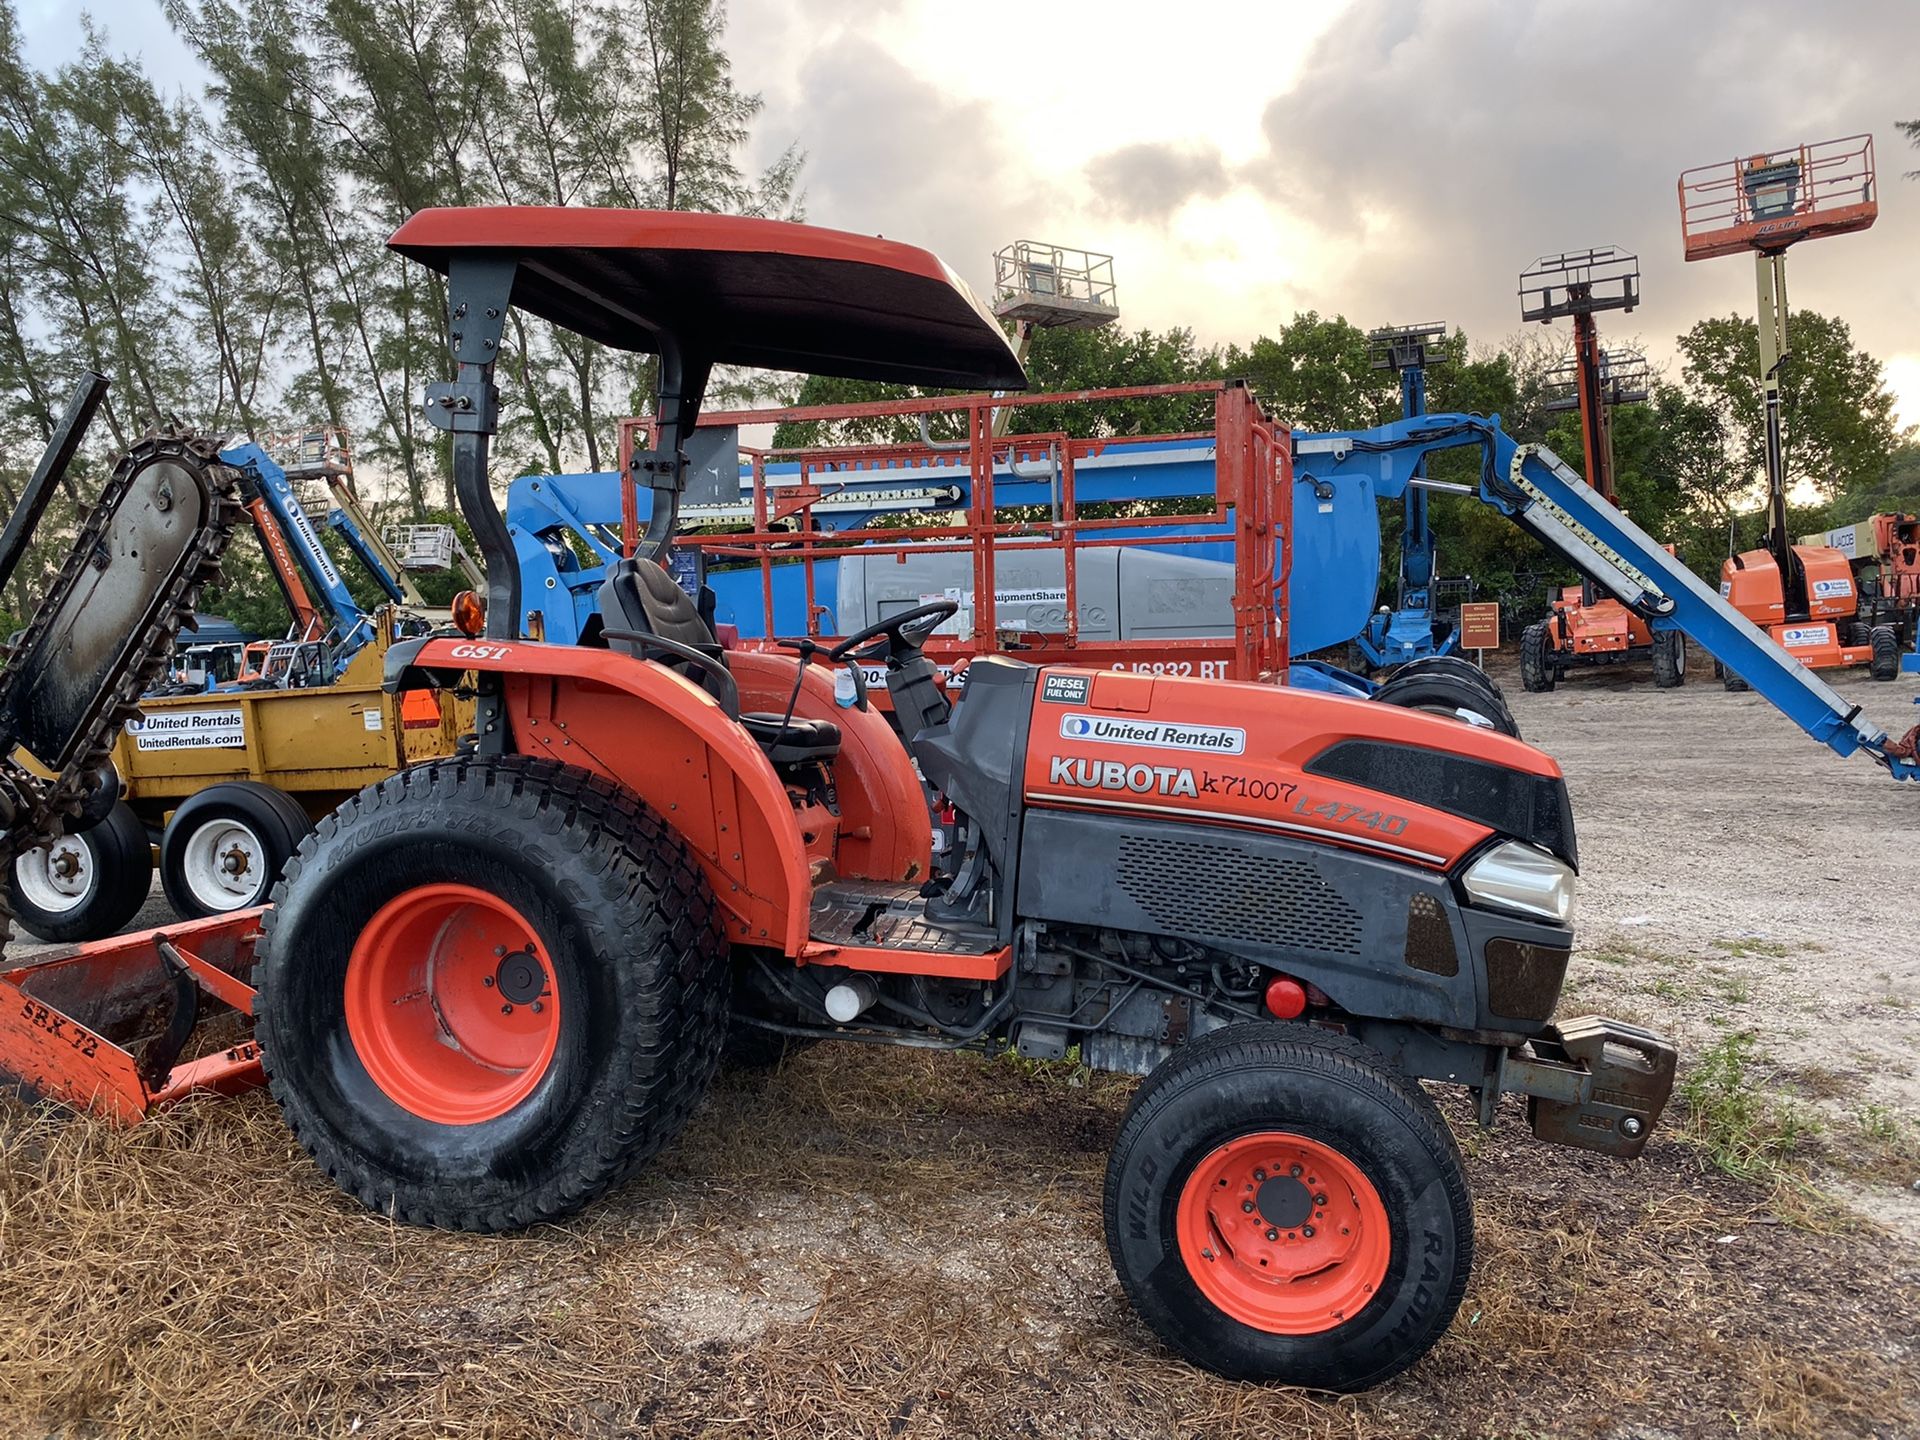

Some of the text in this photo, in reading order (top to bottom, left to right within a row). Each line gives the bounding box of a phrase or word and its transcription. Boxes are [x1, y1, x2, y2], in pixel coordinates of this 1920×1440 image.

[262, 513, 295, 577] SKYTRAK
[296, 517, 335, 582] United Rentals
[1025, 603, 1107, 628] Geie
[451, 644, 512, 660] GST
[1200, 660, 1229, 681] RT
[1046, 689, 1083, 700] FUEL ONLY
[1047, 677, 1085, 690] DIESEL
[147, 714, 241, 730] United Rentals
[139, 735, 242, 748] UnitedRentals.com
[1094, 722, 1235, 748] United Rentals
[1050, 755, 1200, 798] KUBOTA
[1200, 771, 1297, 802] k71007
[1292, 796, 1409, 836] L4740
[1373, 1230, 1444, 1352] RADIAL
